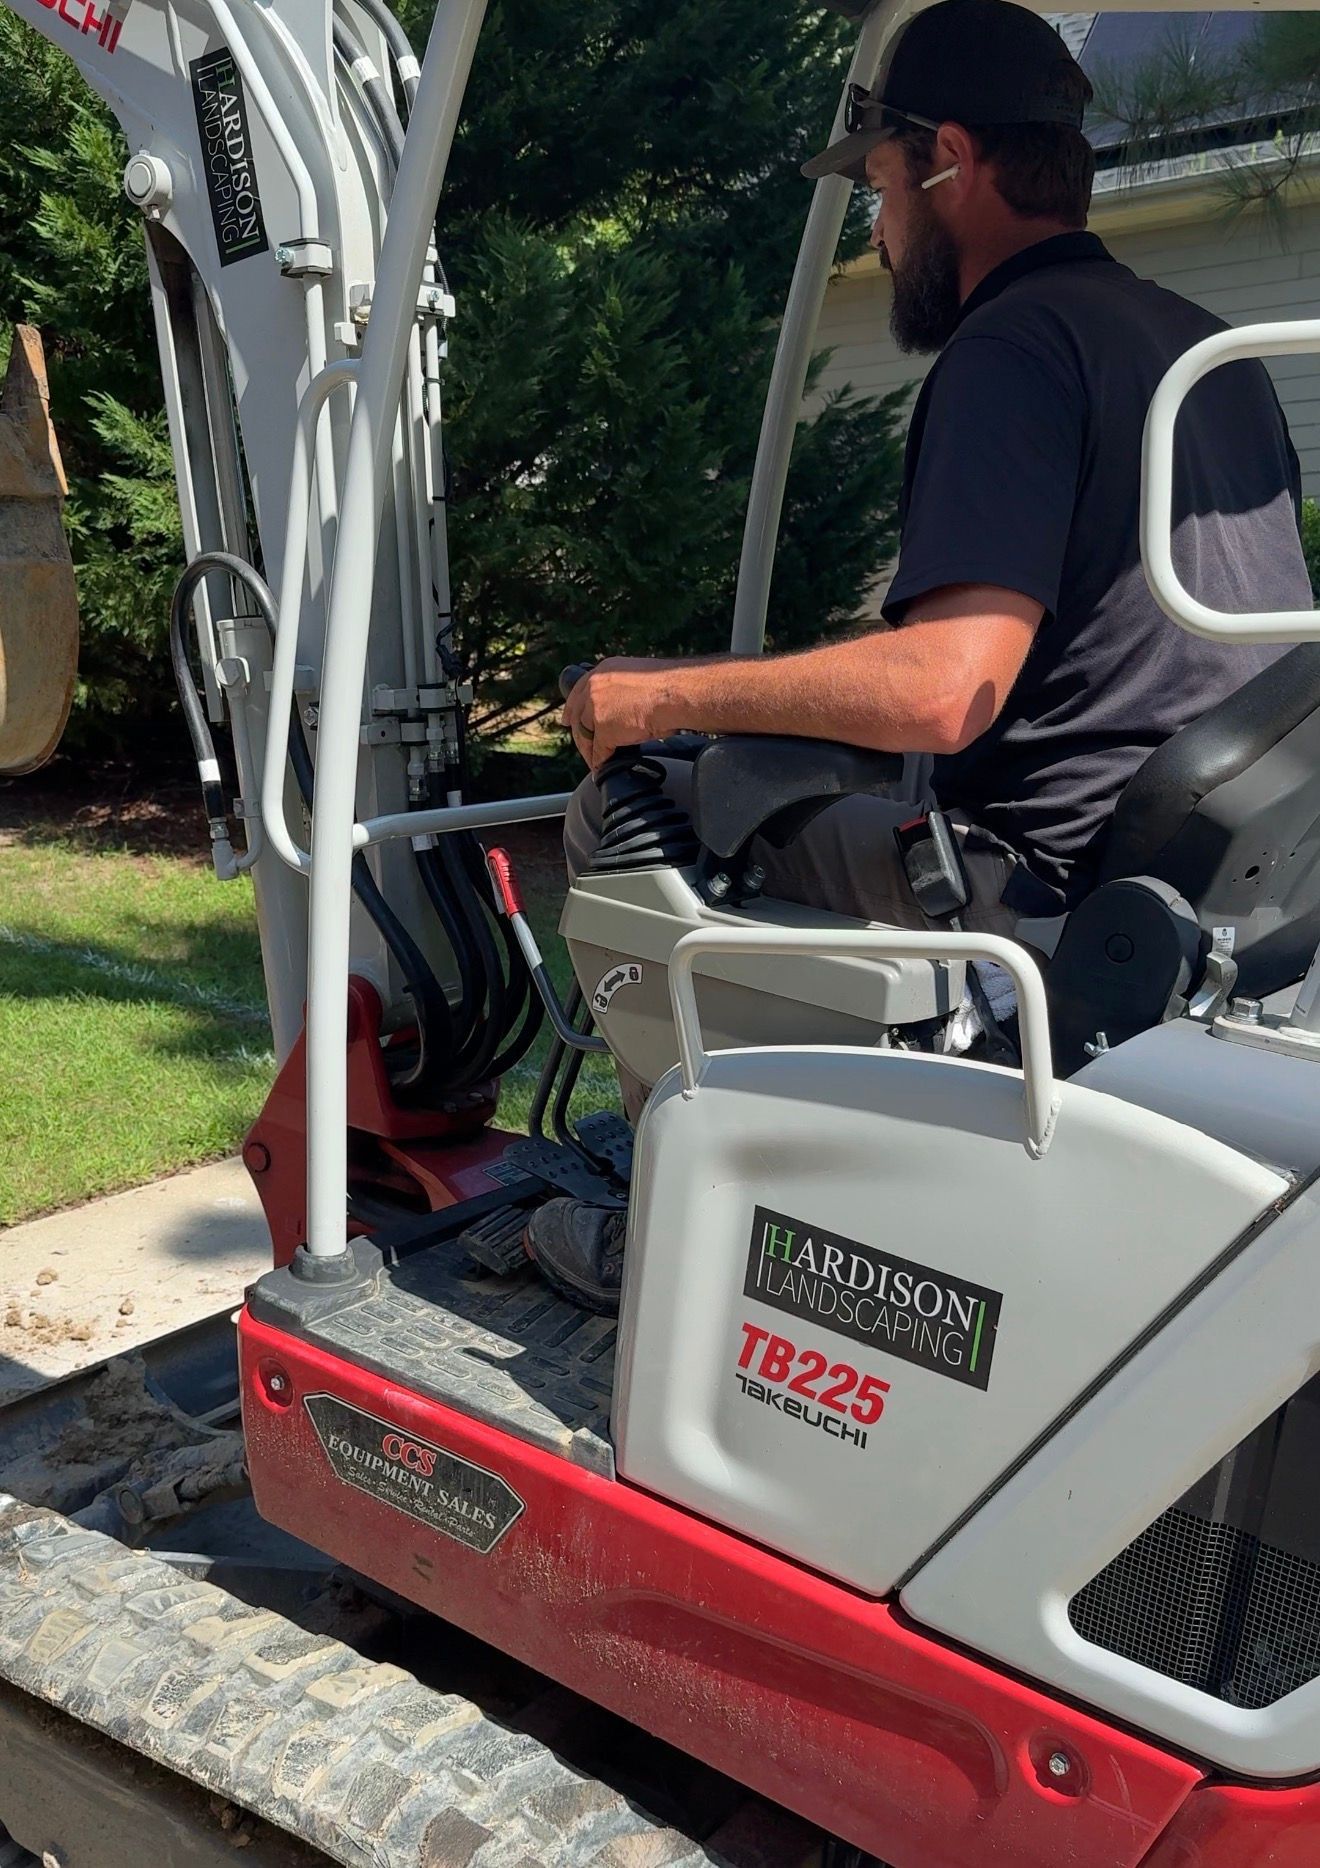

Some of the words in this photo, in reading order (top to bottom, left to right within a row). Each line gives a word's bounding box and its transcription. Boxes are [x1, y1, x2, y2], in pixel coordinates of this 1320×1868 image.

[36, 0, 123, 54] CHI
[198, 73, 239, 243] LANDSCAPING
[215, 60, 260, 239] HARDISON
[765, 1223, 978, 1331] HARDISON
[766, 1262, 964, 1365] LANDSCAPING
[737, 1322, 891, 1425] TB225
[328, 1435, 433, 1497] EQUIPMENT
[437, 1490, 496, 1530] SALES
[382, 1433, 437, 1477] CCS
